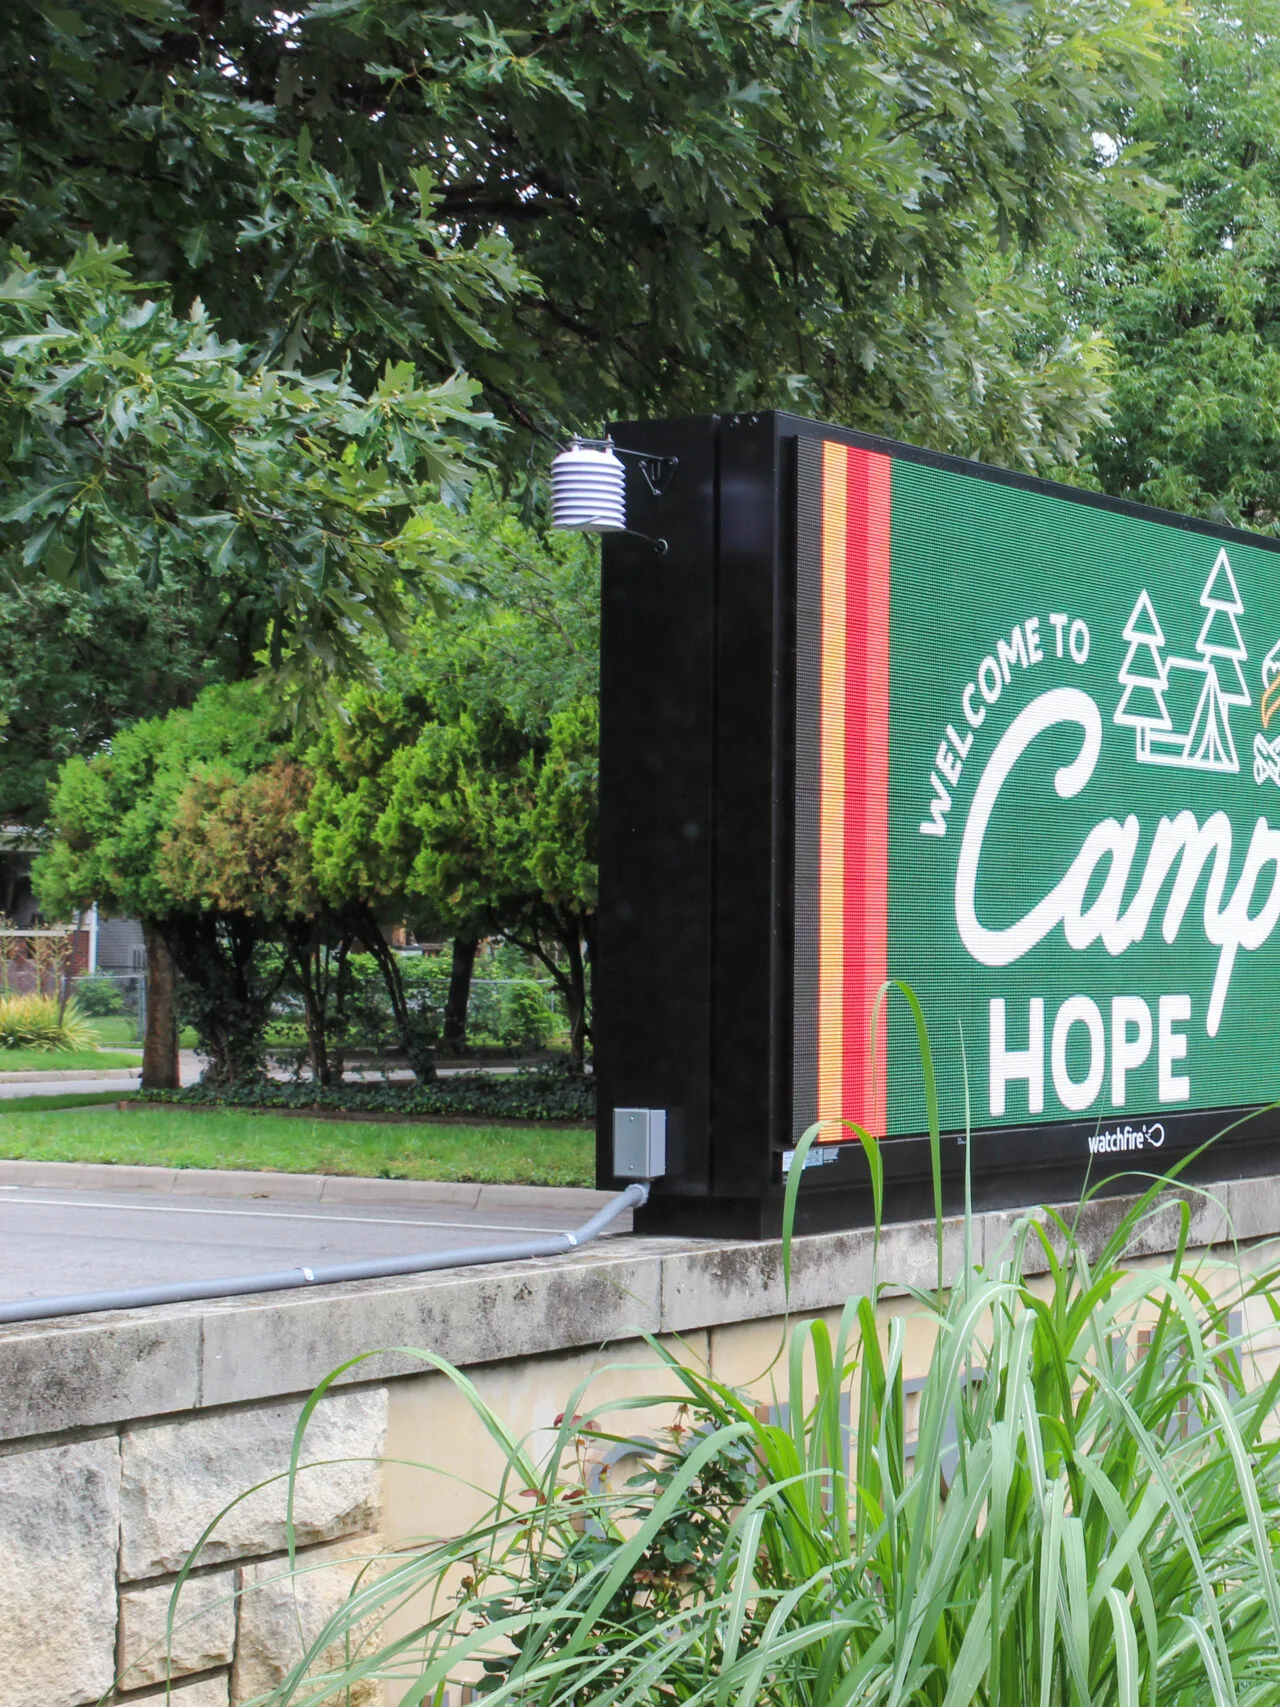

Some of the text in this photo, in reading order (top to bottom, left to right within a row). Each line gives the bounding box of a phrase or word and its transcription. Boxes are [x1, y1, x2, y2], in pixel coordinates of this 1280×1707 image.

[919, 612, 1091, 838] WELCOME TO
[988, 994, 1192, 1117] HOPE
[1087, 1125, 1145, 1154] watchfire
